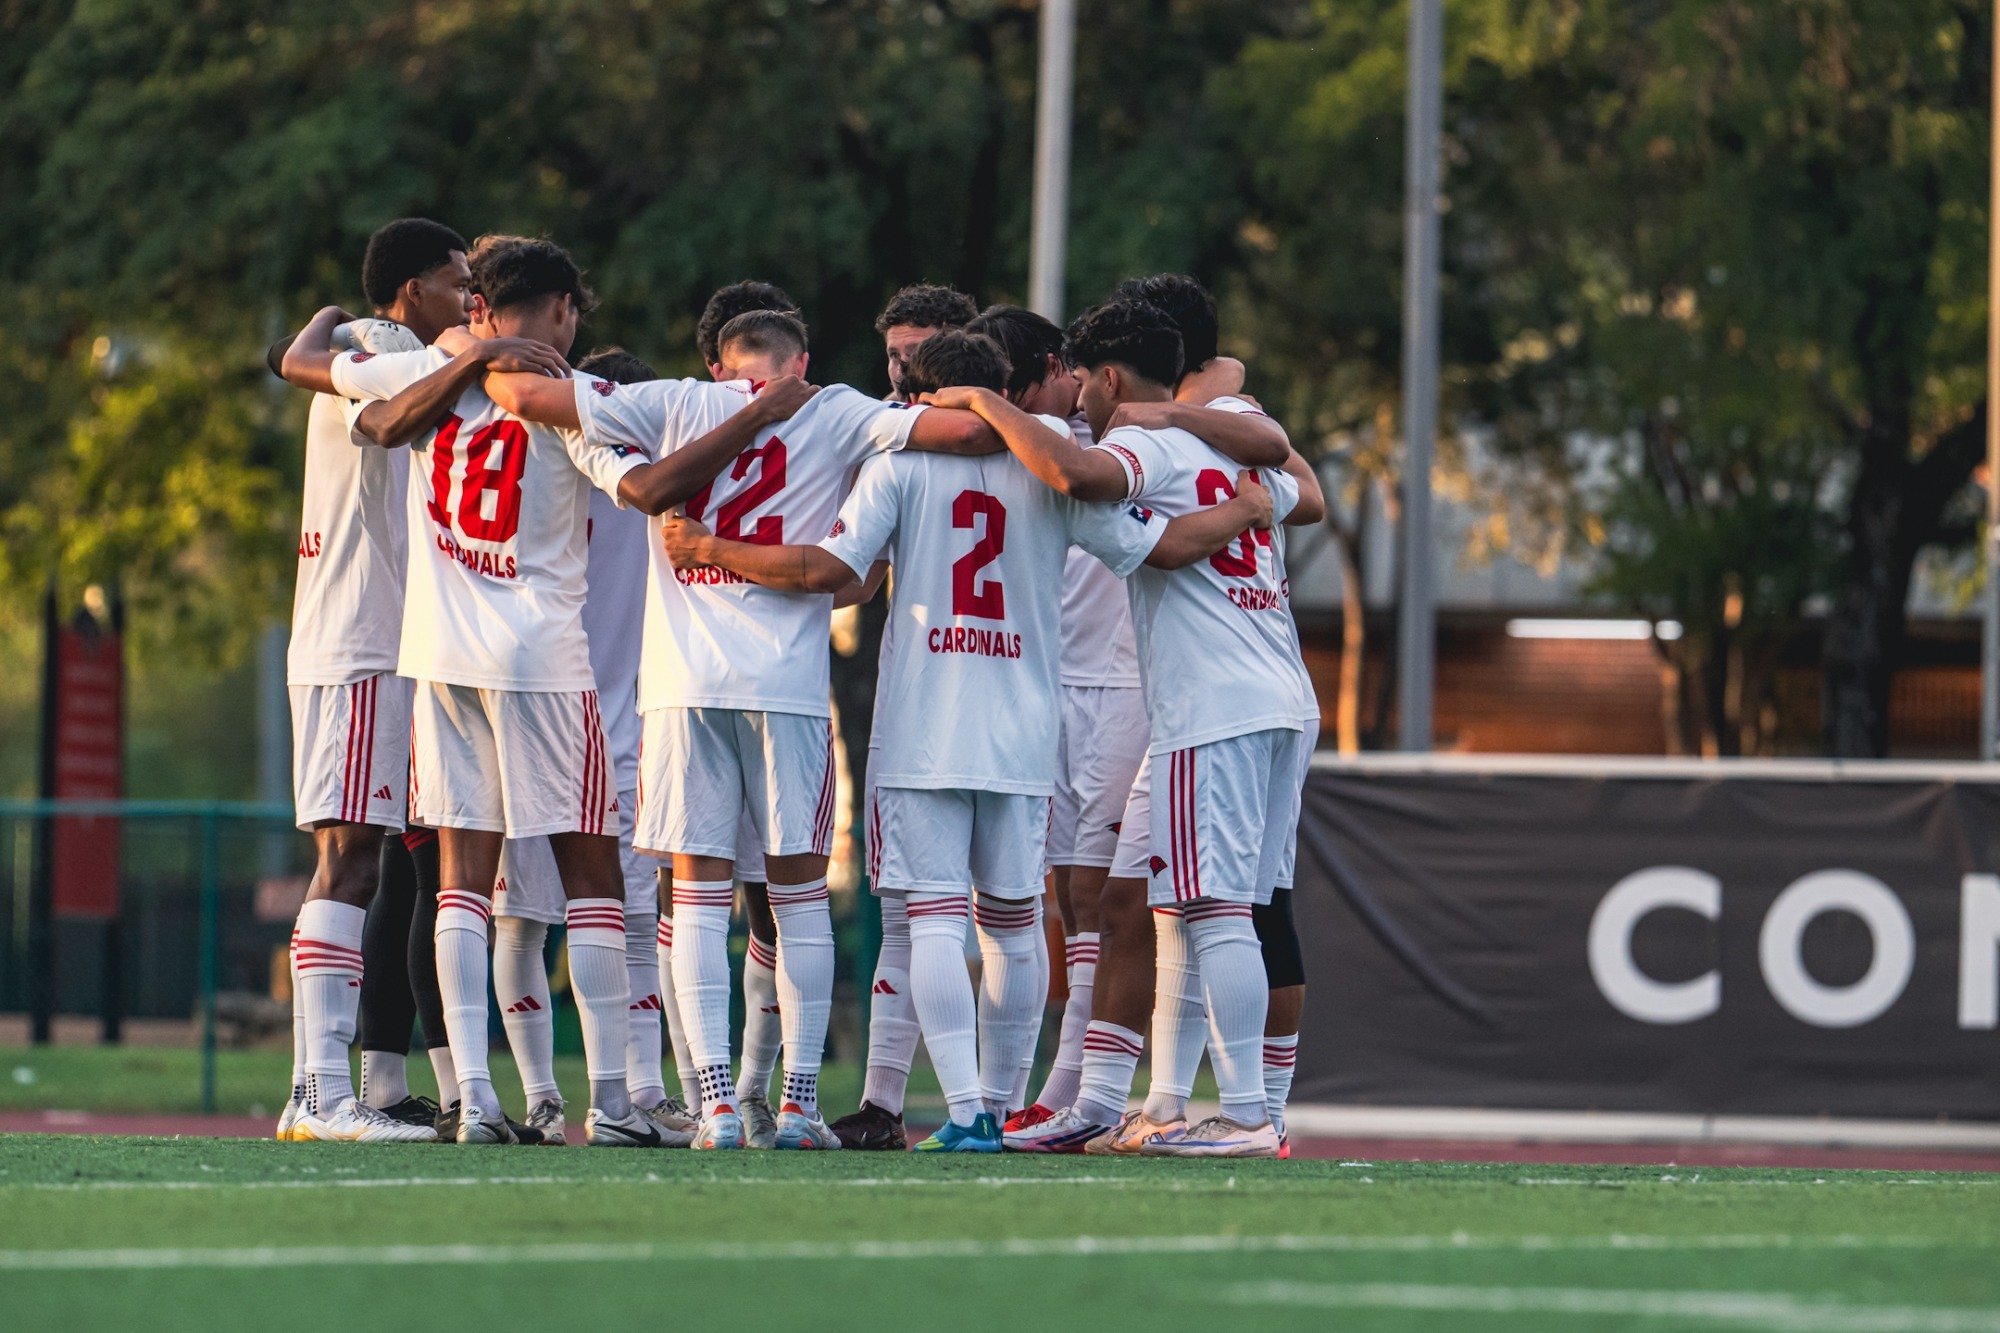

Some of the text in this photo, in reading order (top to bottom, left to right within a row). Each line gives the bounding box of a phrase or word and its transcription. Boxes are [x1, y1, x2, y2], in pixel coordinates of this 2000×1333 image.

[427, 411, 529, 543] 18
[437, 533, 516, 579] CRDNALS
[674, 565, 759, 586] CARDIN
[952, 489, 1006, 620] 2
[928, 627, 1021, 659] CARDINALS
